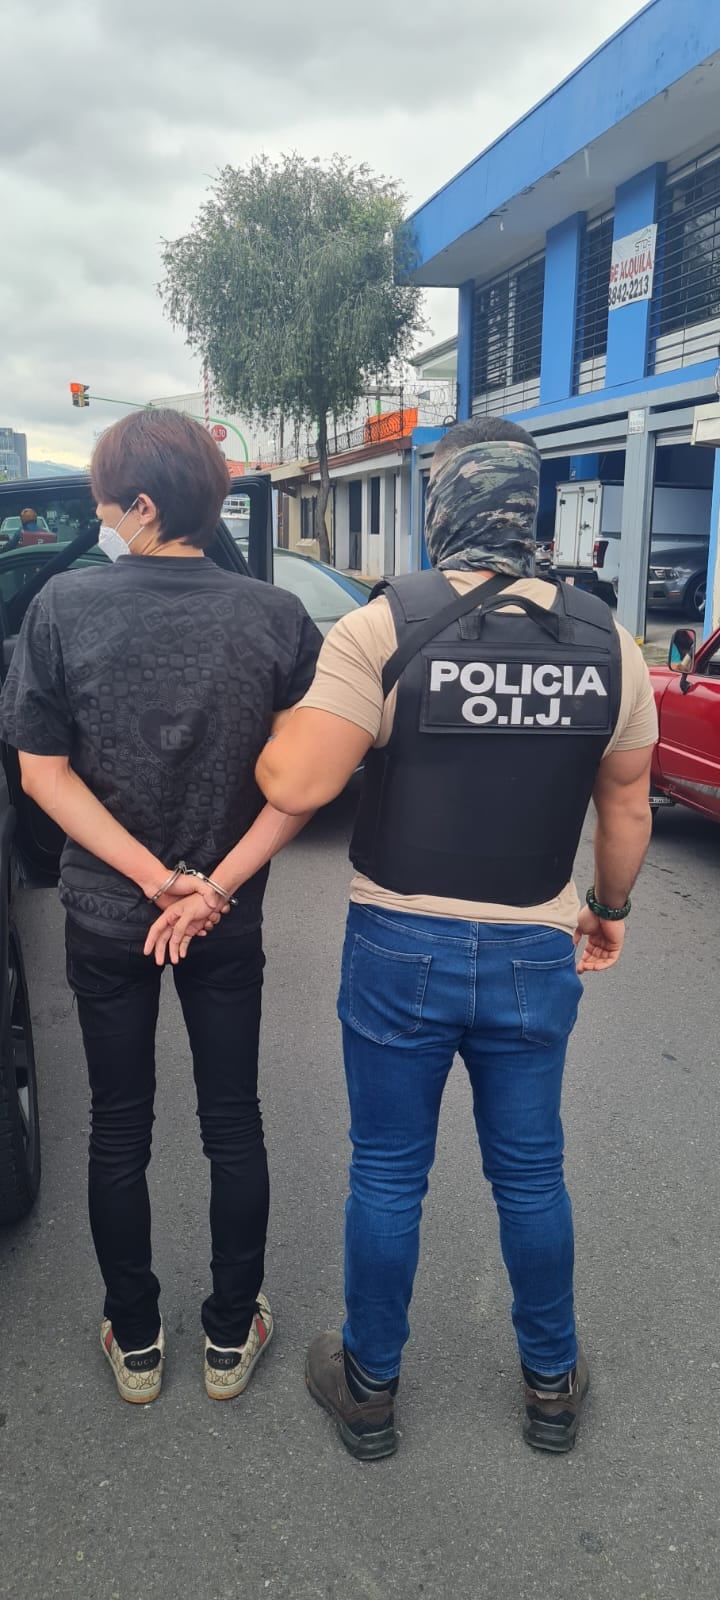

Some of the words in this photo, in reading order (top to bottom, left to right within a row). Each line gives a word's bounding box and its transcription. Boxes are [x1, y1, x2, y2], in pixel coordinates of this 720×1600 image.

[619, 251, 652, 281] ALQUILA
[212, 428, 226, 437] ALTO
[430, 660, 607, 696] POLICIA
[461, 695, 572, 726] O.I.J.
[160, 724, 193, 750] DG
[209, 1355, 234, 1366] UCCI
